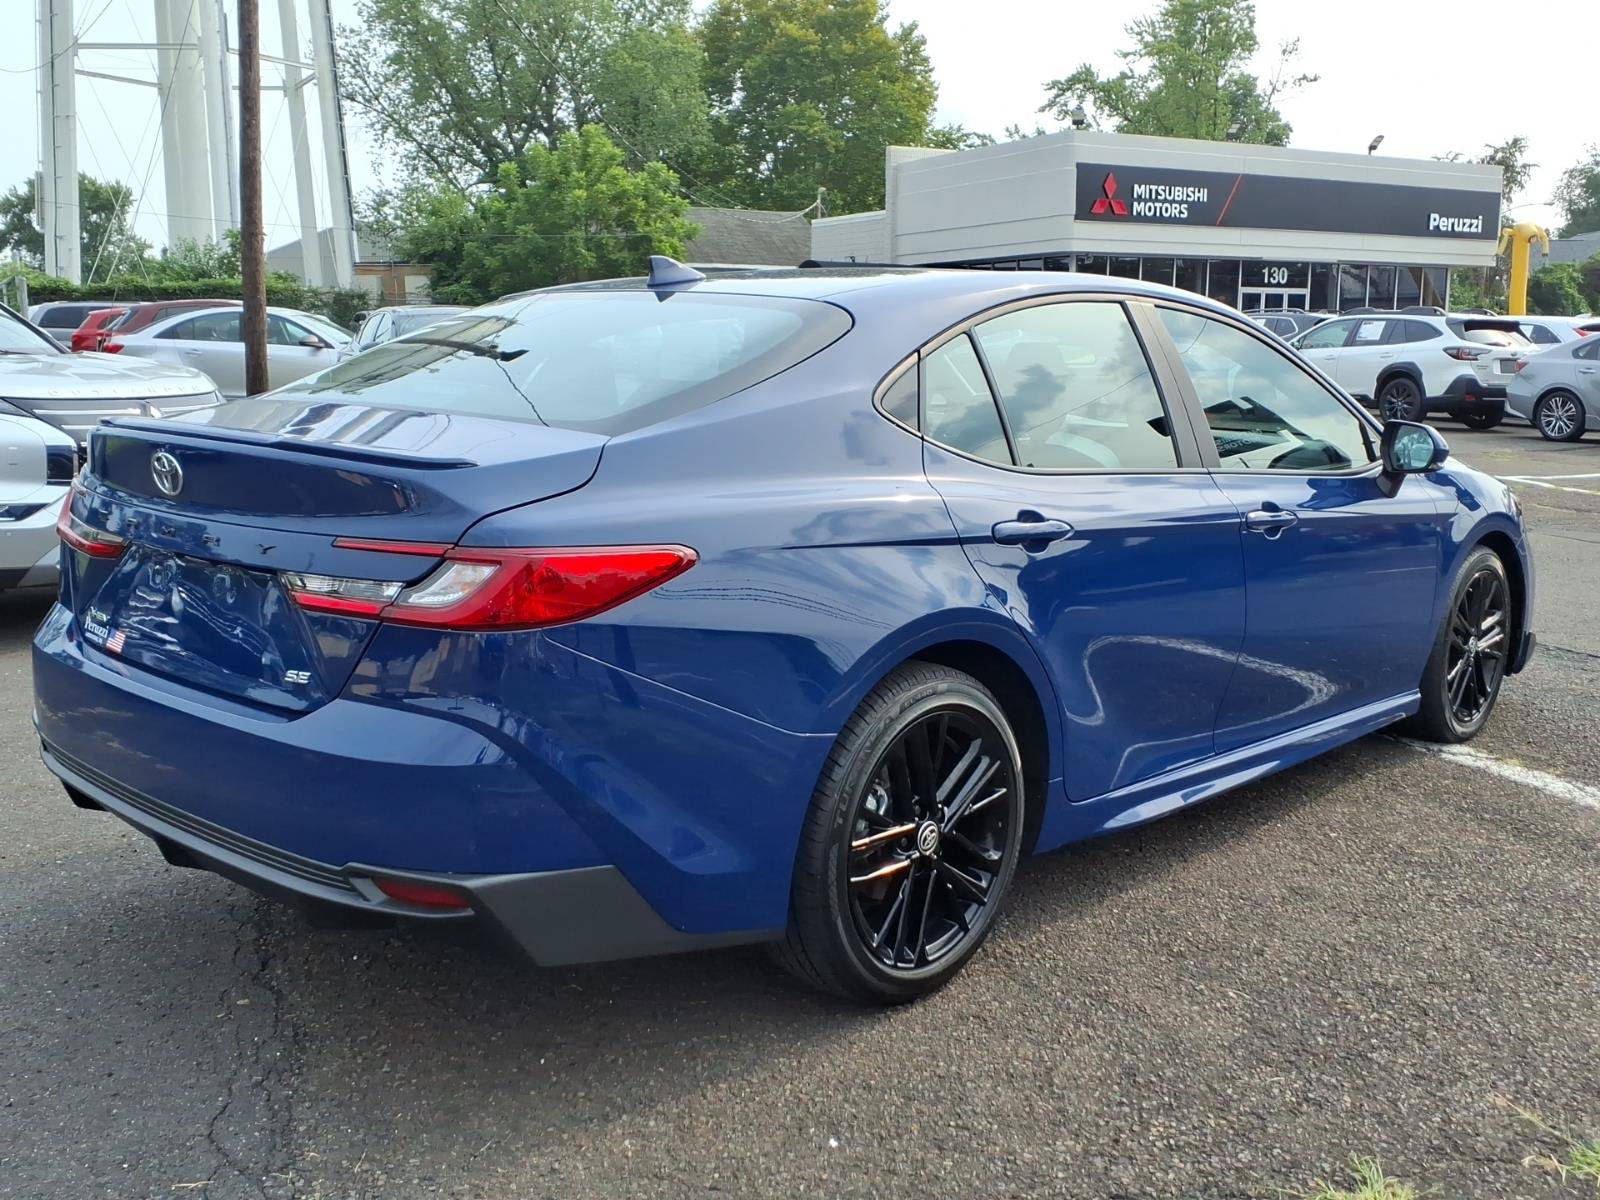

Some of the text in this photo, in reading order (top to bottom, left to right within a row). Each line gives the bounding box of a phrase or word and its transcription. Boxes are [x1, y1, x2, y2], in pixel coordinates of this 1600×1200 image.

[1133, 184, 1208, 202] MITSUBISHI
[1132, 202, 1188, 218] MOTORS
[1429, 212, 1483, 233] Peruzzi
[1262, 266, 1288, 284] 130
[284, 669, 312, 684] SE
